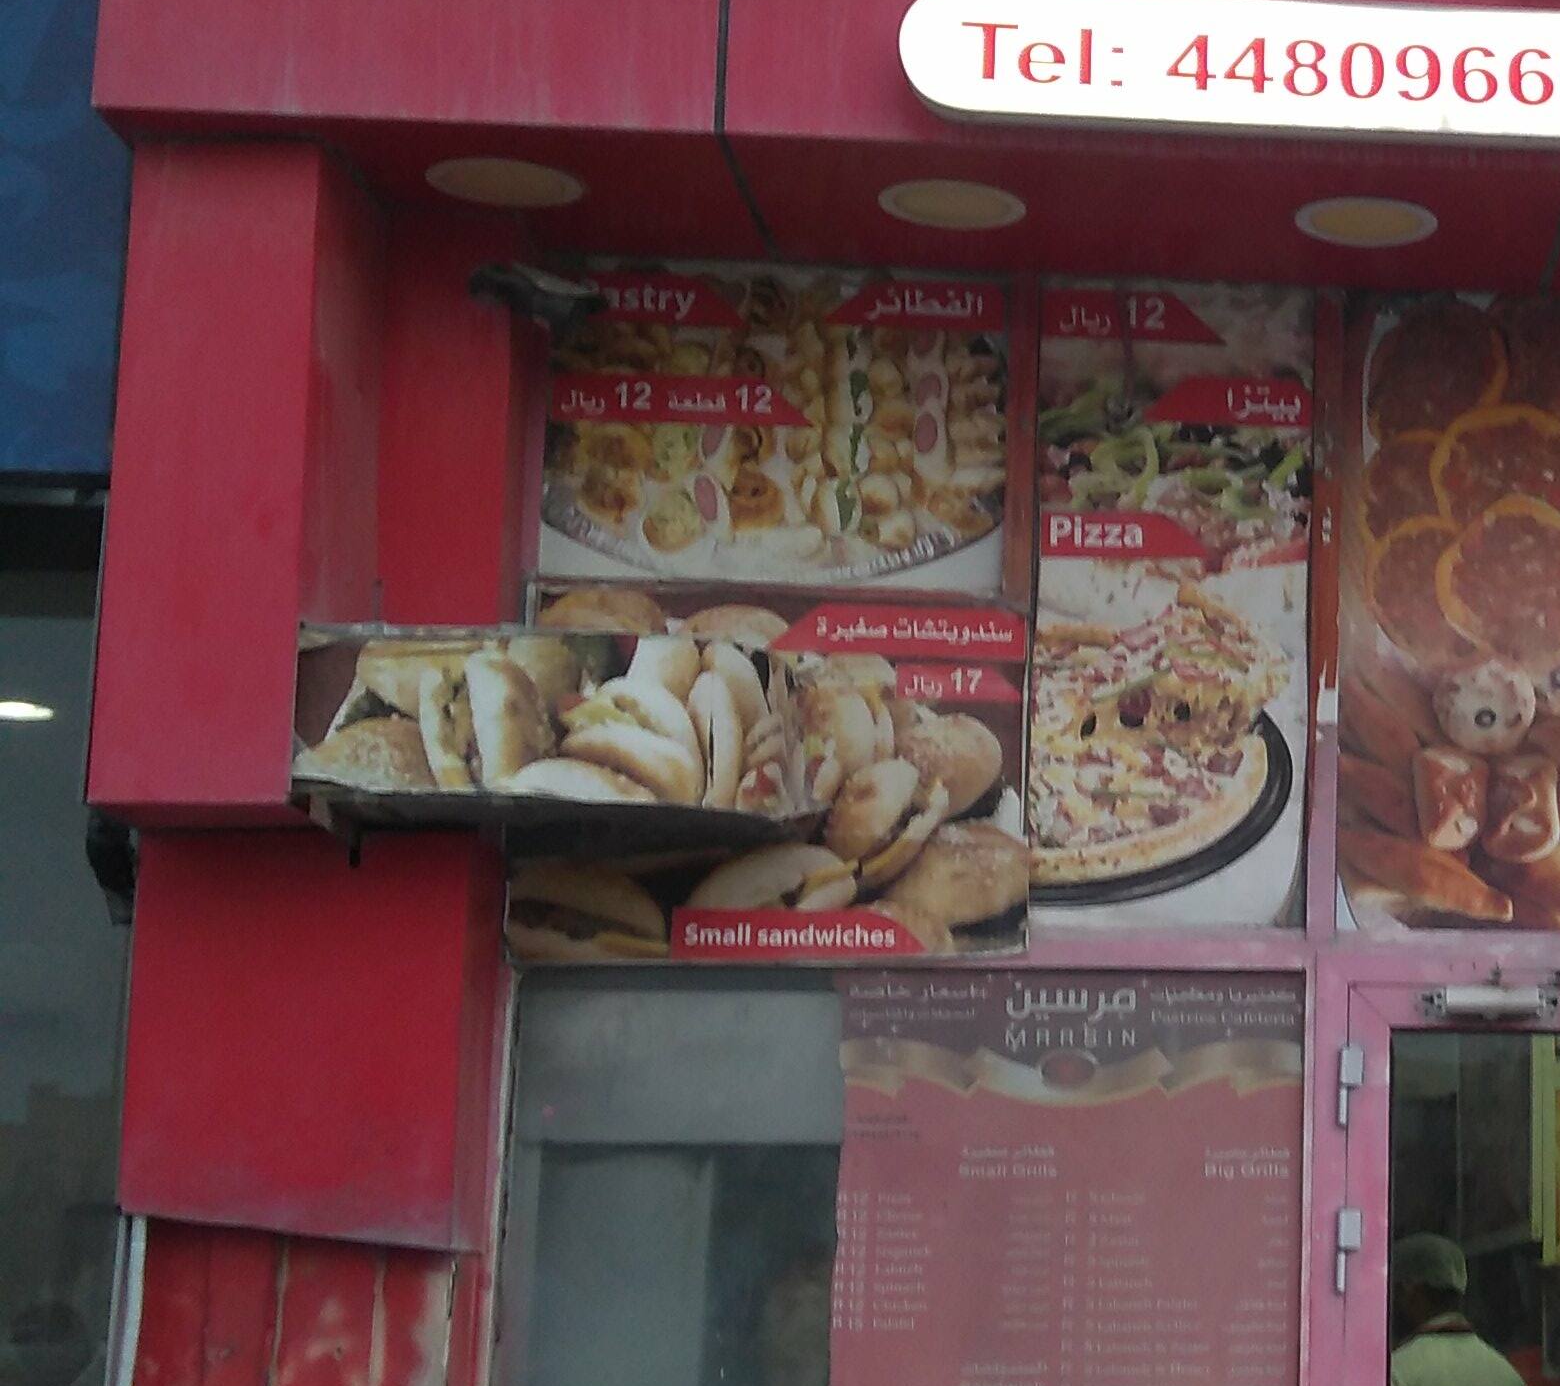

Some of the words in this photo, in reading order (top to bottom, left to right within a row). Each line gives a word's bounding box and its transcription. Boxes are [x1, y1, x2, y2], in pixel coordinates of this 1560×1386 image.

[962, 20, 1125, 89] Tel:
[600, 284, 698, 321] astry
[865, 286, 985, 320] الفطائر
[1126, 295, 1166, 331] 12
[1058, 304, 1112, 336] ريال
[560, 388, 606, 415] ريال
[614, 381, 652, 412] 12
[667, 386, 727, 413] قطعة
[734, 384, 774, 414] 12
[1226, 384, 1301, 424] بيتزا
[1050, 515, 1145, 550] Pizza
[815, 615, 889, 643] صغيرة
[892, 616, 1014, 646] سندويتشات
[904, 673, 944, 699] ريال
[950, 667, 983, 695] 17
[684, 921, 751, 948] Small
[756, 922, 897, 949] sandwiches
[1006, 981, 1138, 1022] مرسين
